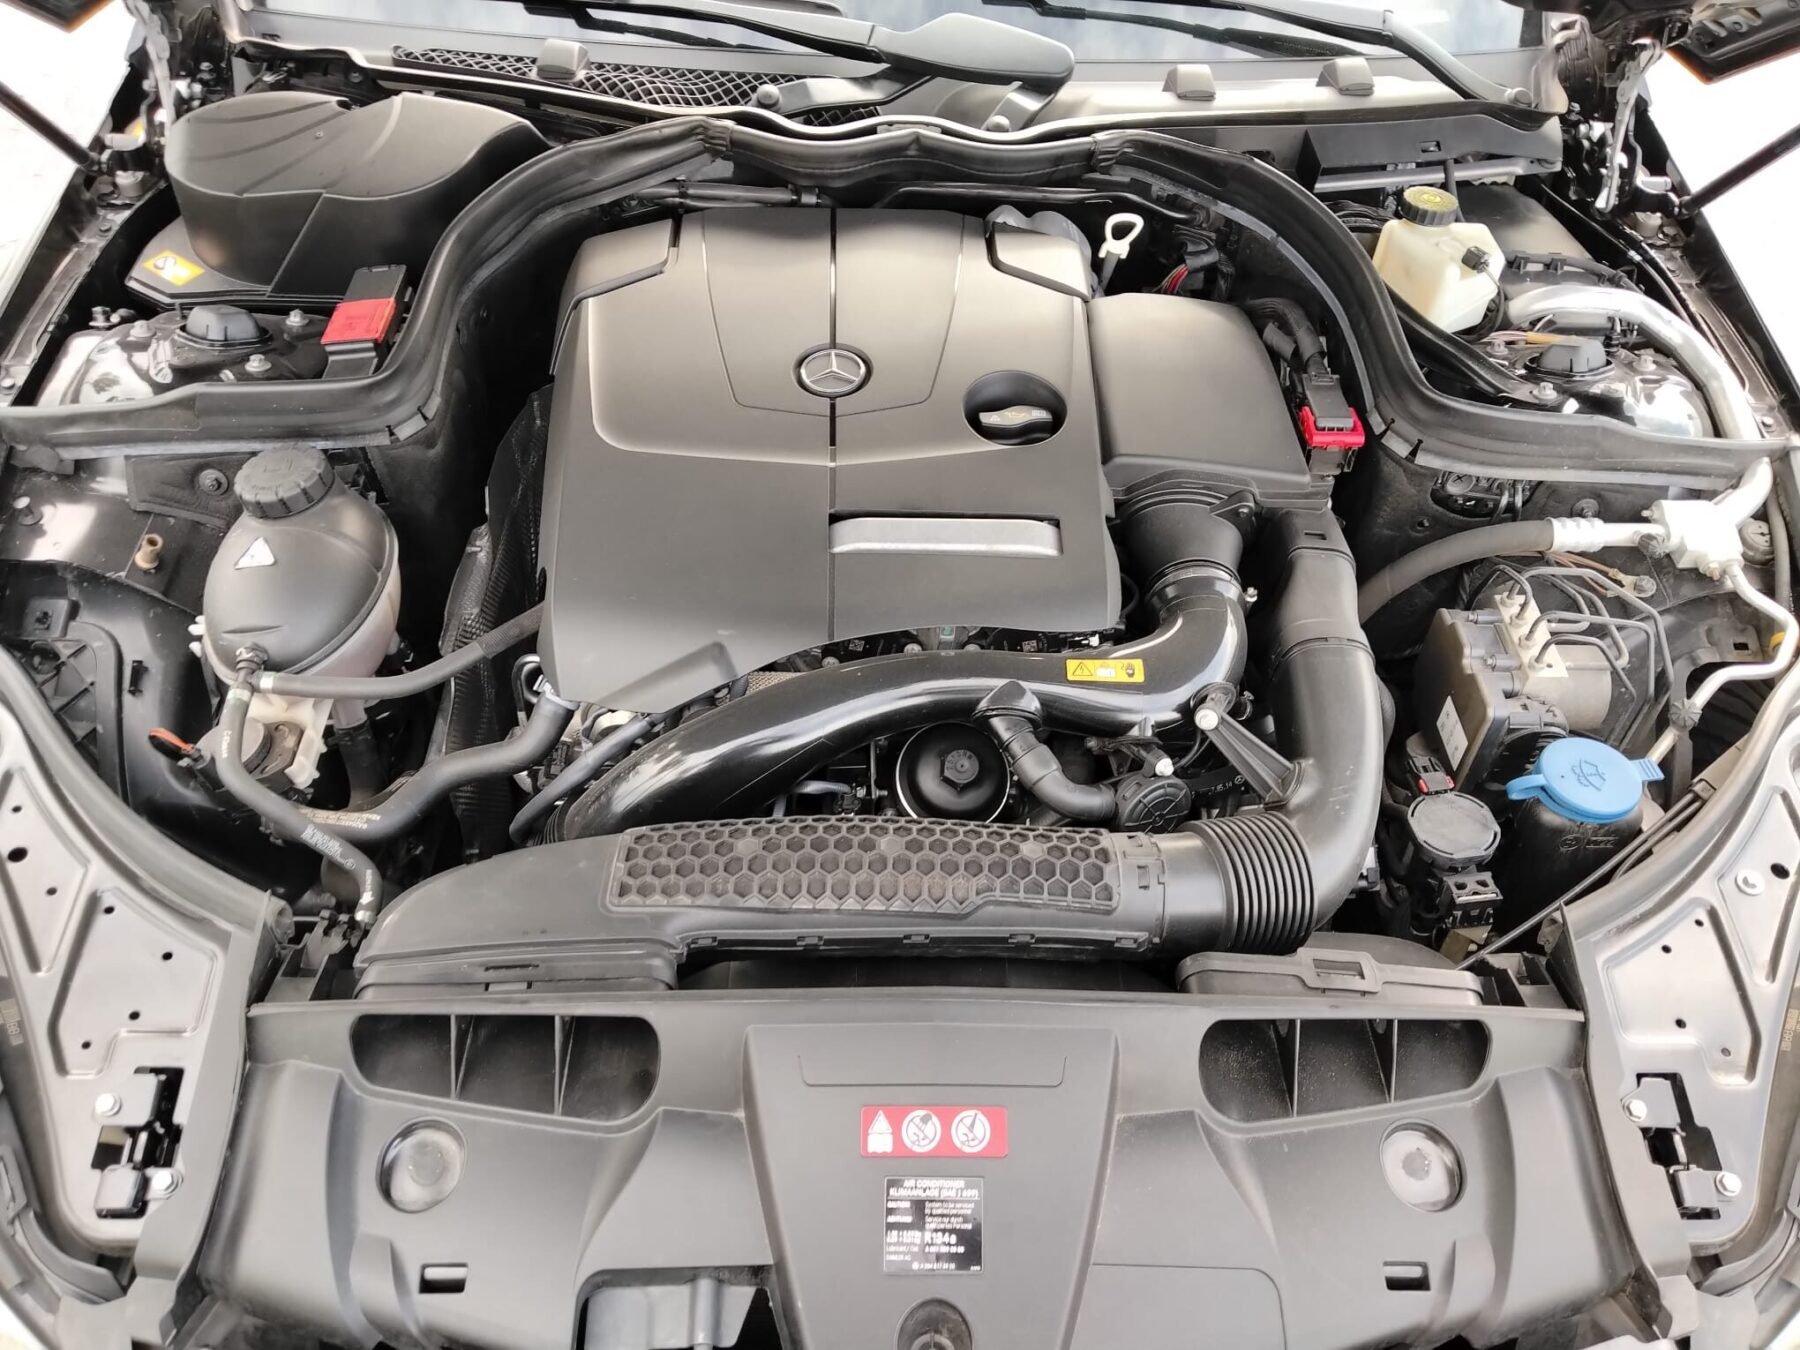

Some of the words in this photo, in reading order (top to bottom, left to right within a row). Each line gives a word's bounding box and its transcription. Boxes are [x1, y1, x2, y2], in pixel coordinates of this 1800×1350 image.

[903, 1179, 916, 1188] AIR
[916, 1179, 965, 1189] CONDITIONER
[889, 1187, 939, 1198] KLIMAANLAGE
[924, 1231, 957, 1245] R134a
